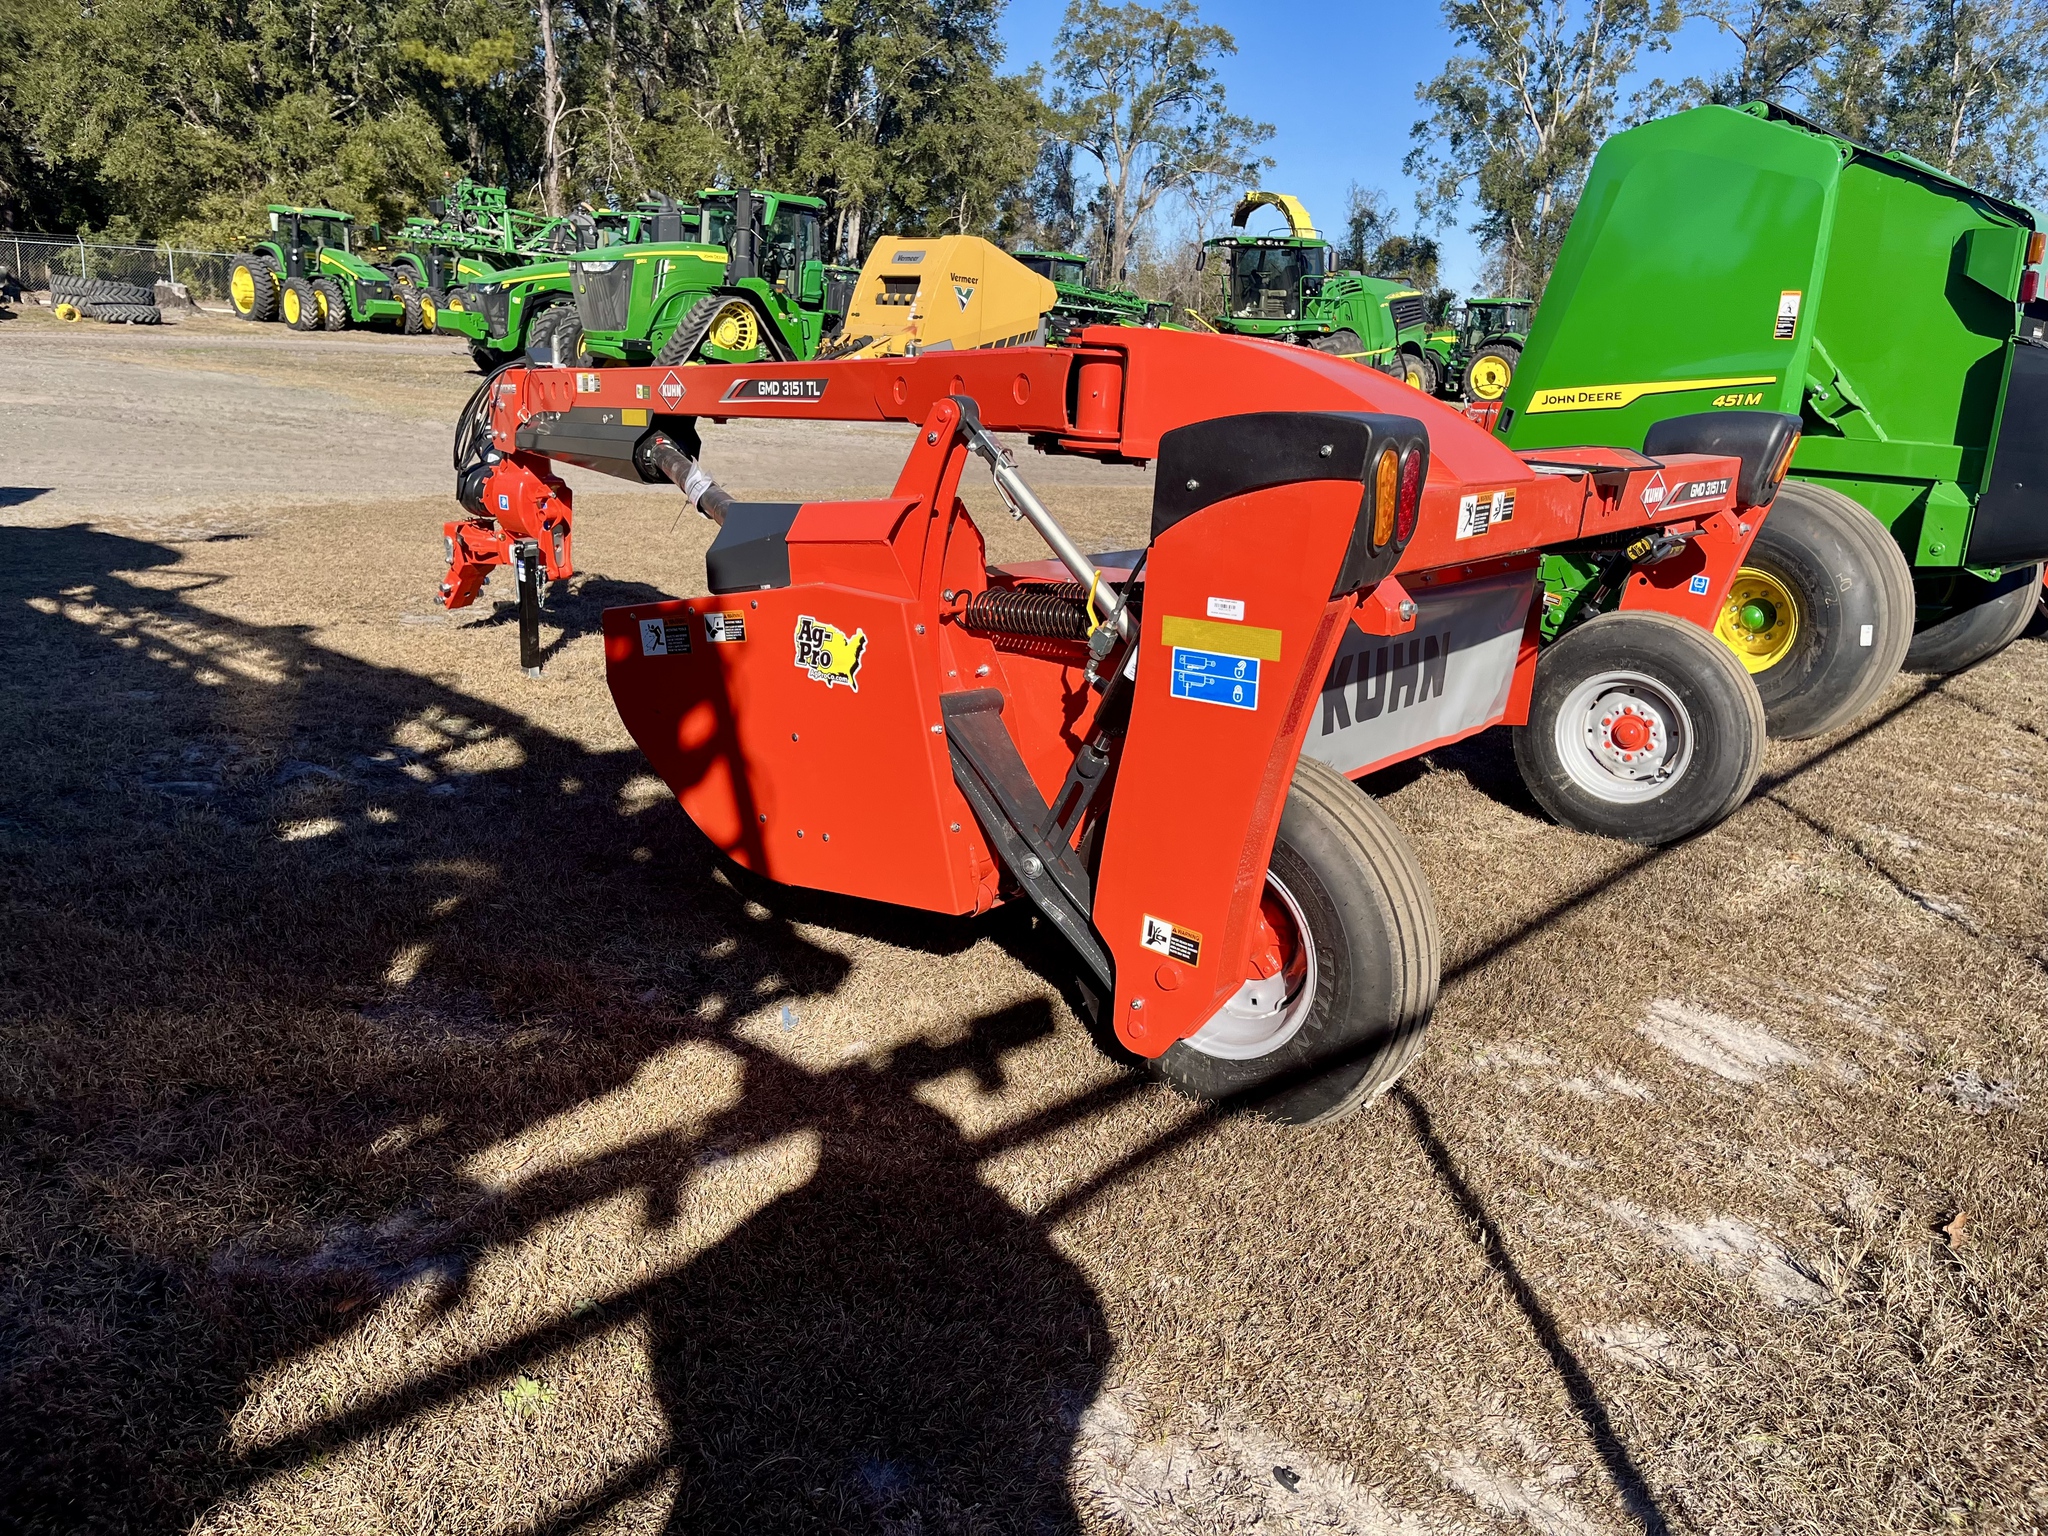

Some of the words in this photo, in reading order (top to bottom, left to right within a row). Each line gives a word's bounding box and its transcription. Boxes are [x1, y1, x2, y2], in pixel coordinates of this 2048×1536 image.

[950, 272, 979, 285] Vermeer
[661, 384, 682, 398] KUHN
[757, 381, 780, 396] GMD
[782, 381, 803, 396] 3151
[806, 381, 821, 396] TL
[1541, 394, 1576, 405] JOHN
[1578, 391, 1623, 403] DEERE
[1644, 486, 1664, 504] KUHN
[1690, 483, 1706, 498] GMD
[1705, 481, 1719, 496] 3151
[1720, 480, 1727, 494] TL
[798, 619, 831, 648] Ag-
[798, 642, 832, 667] Pro
[809, 668, 849, 683] AgProCo.com
[1321, 632, 1451, 737] KUHN
[1177, 929, 1200, 942] WARNING
